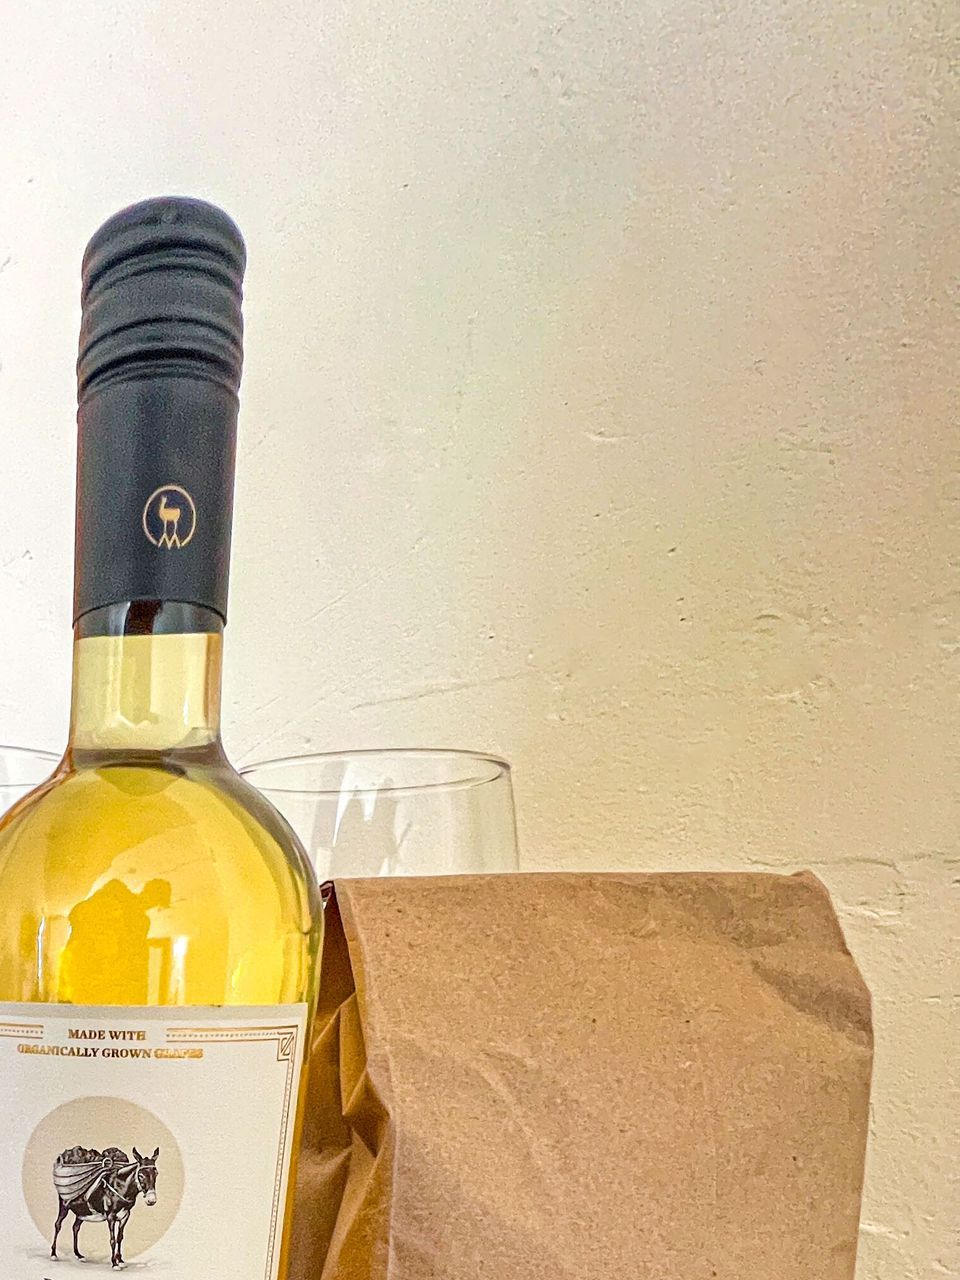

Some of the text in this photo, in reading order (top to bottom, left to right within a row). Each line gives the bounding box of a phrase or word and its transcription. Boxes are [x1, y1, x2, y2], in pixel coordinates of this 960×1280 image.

[68, 1029, 146, 1041] MADE WITH
[17, 1043, 99, 1058] ORGANICALLY
[101, 1046, 151, 1058] GROWN
